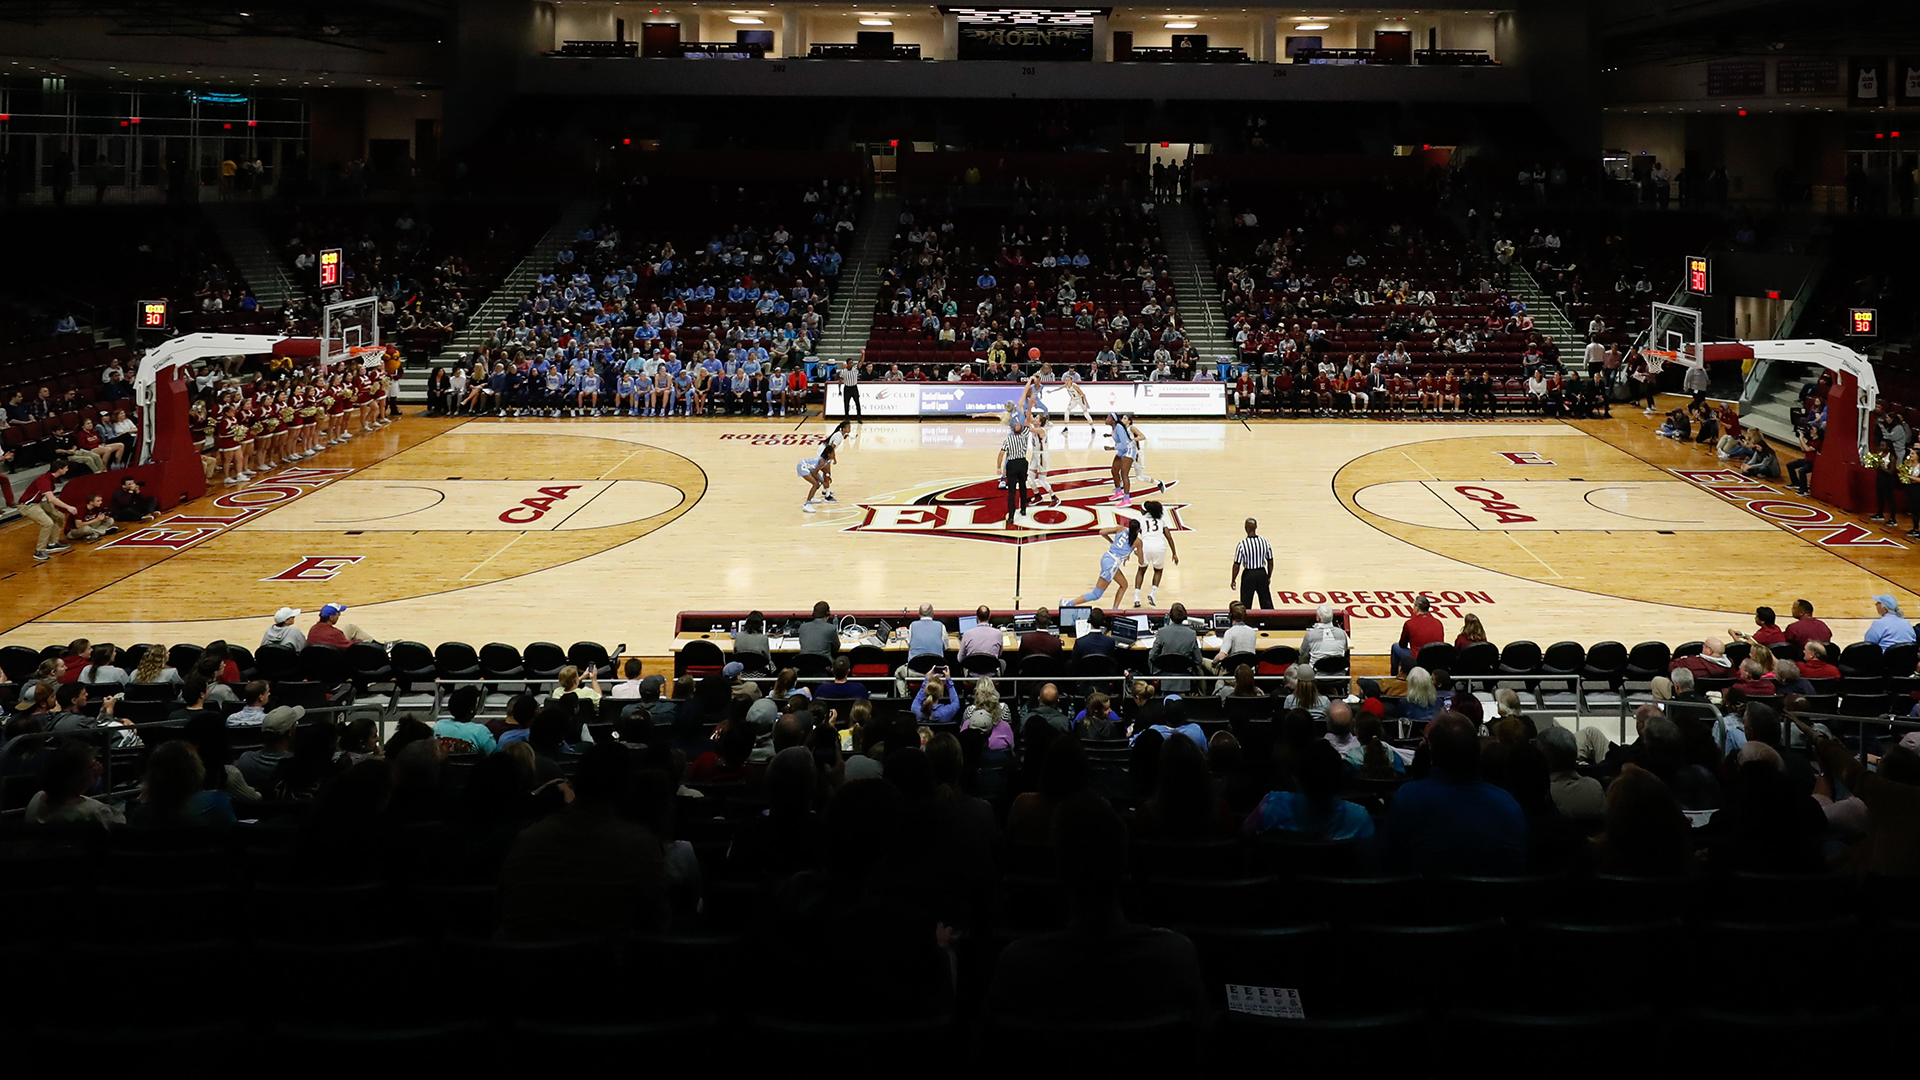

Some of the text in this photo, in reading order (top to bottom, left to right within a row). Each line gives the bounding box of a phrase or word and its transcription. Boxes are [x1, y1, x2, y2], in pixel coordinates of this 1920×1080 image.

[1022, 67, 1036, 75] 203
[1273, 69, 1287, 77] 204
[321, 264, 336, 285] 30
[1691, 271, 1706, 291] 30
[145, 313, 160, 325] 30
[1854, 312, 1872, 321] 10:00
[1855, 321, 1870, 332] 30
[1143, 385, 1154, 397] E
[1491, 451, 1558, 466] E
[93, 466, 355, 551] ELON
[498, 485, 583, 524] CAA
[1454, 486, 1538, 524] CAA
[1666, 468, 1909, 550] ELON
[868, 504, 1178, 531] ELON
[1145, 519, 1159, 533] 13
[257, 555, 367, 582] E
[1277, 590, 1496, 604] ROBERTSON
[1230, 986, 1297, 997] E E E E E
